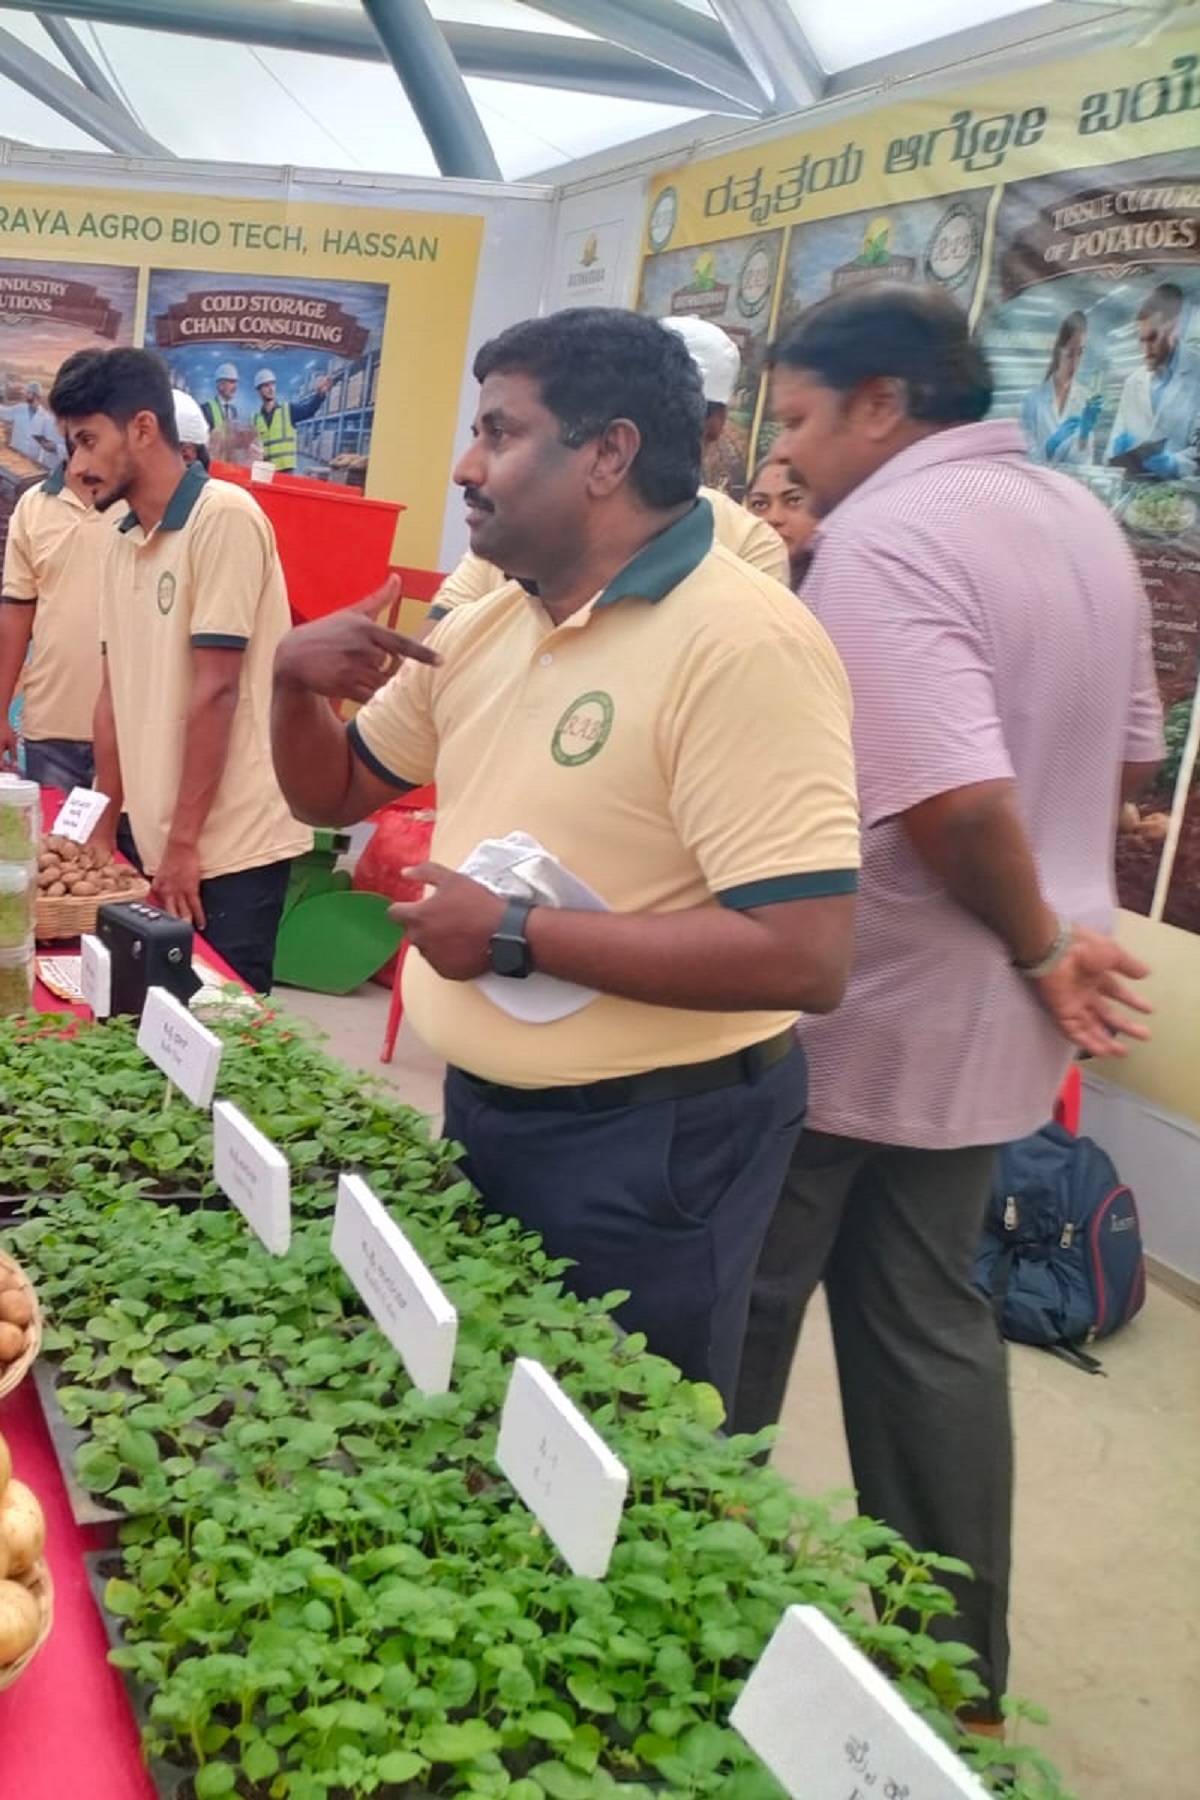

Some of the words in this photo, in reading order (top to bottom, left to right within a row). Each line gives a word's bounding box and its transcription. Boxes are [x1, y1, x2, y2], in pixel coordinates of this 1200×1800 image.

[1052, 194, 1116, 231] TISSUE
[77, 212, 163, 243] AGRO
[171, 217, 221, 246] BIO
[229, 221, 308, 255] TECH,
[322, 228, 439, 262] HASSAN
[1043, 243, 1070, 262] OF
[1068, 217, 1197, 262] POTATOES
[201, 295, 248, 312] COLD
[249, 295, 328, 319] STORAGE
[179, 317, 237, 335] CHAIN
[238, 316, 343, 343] CONSULTING
